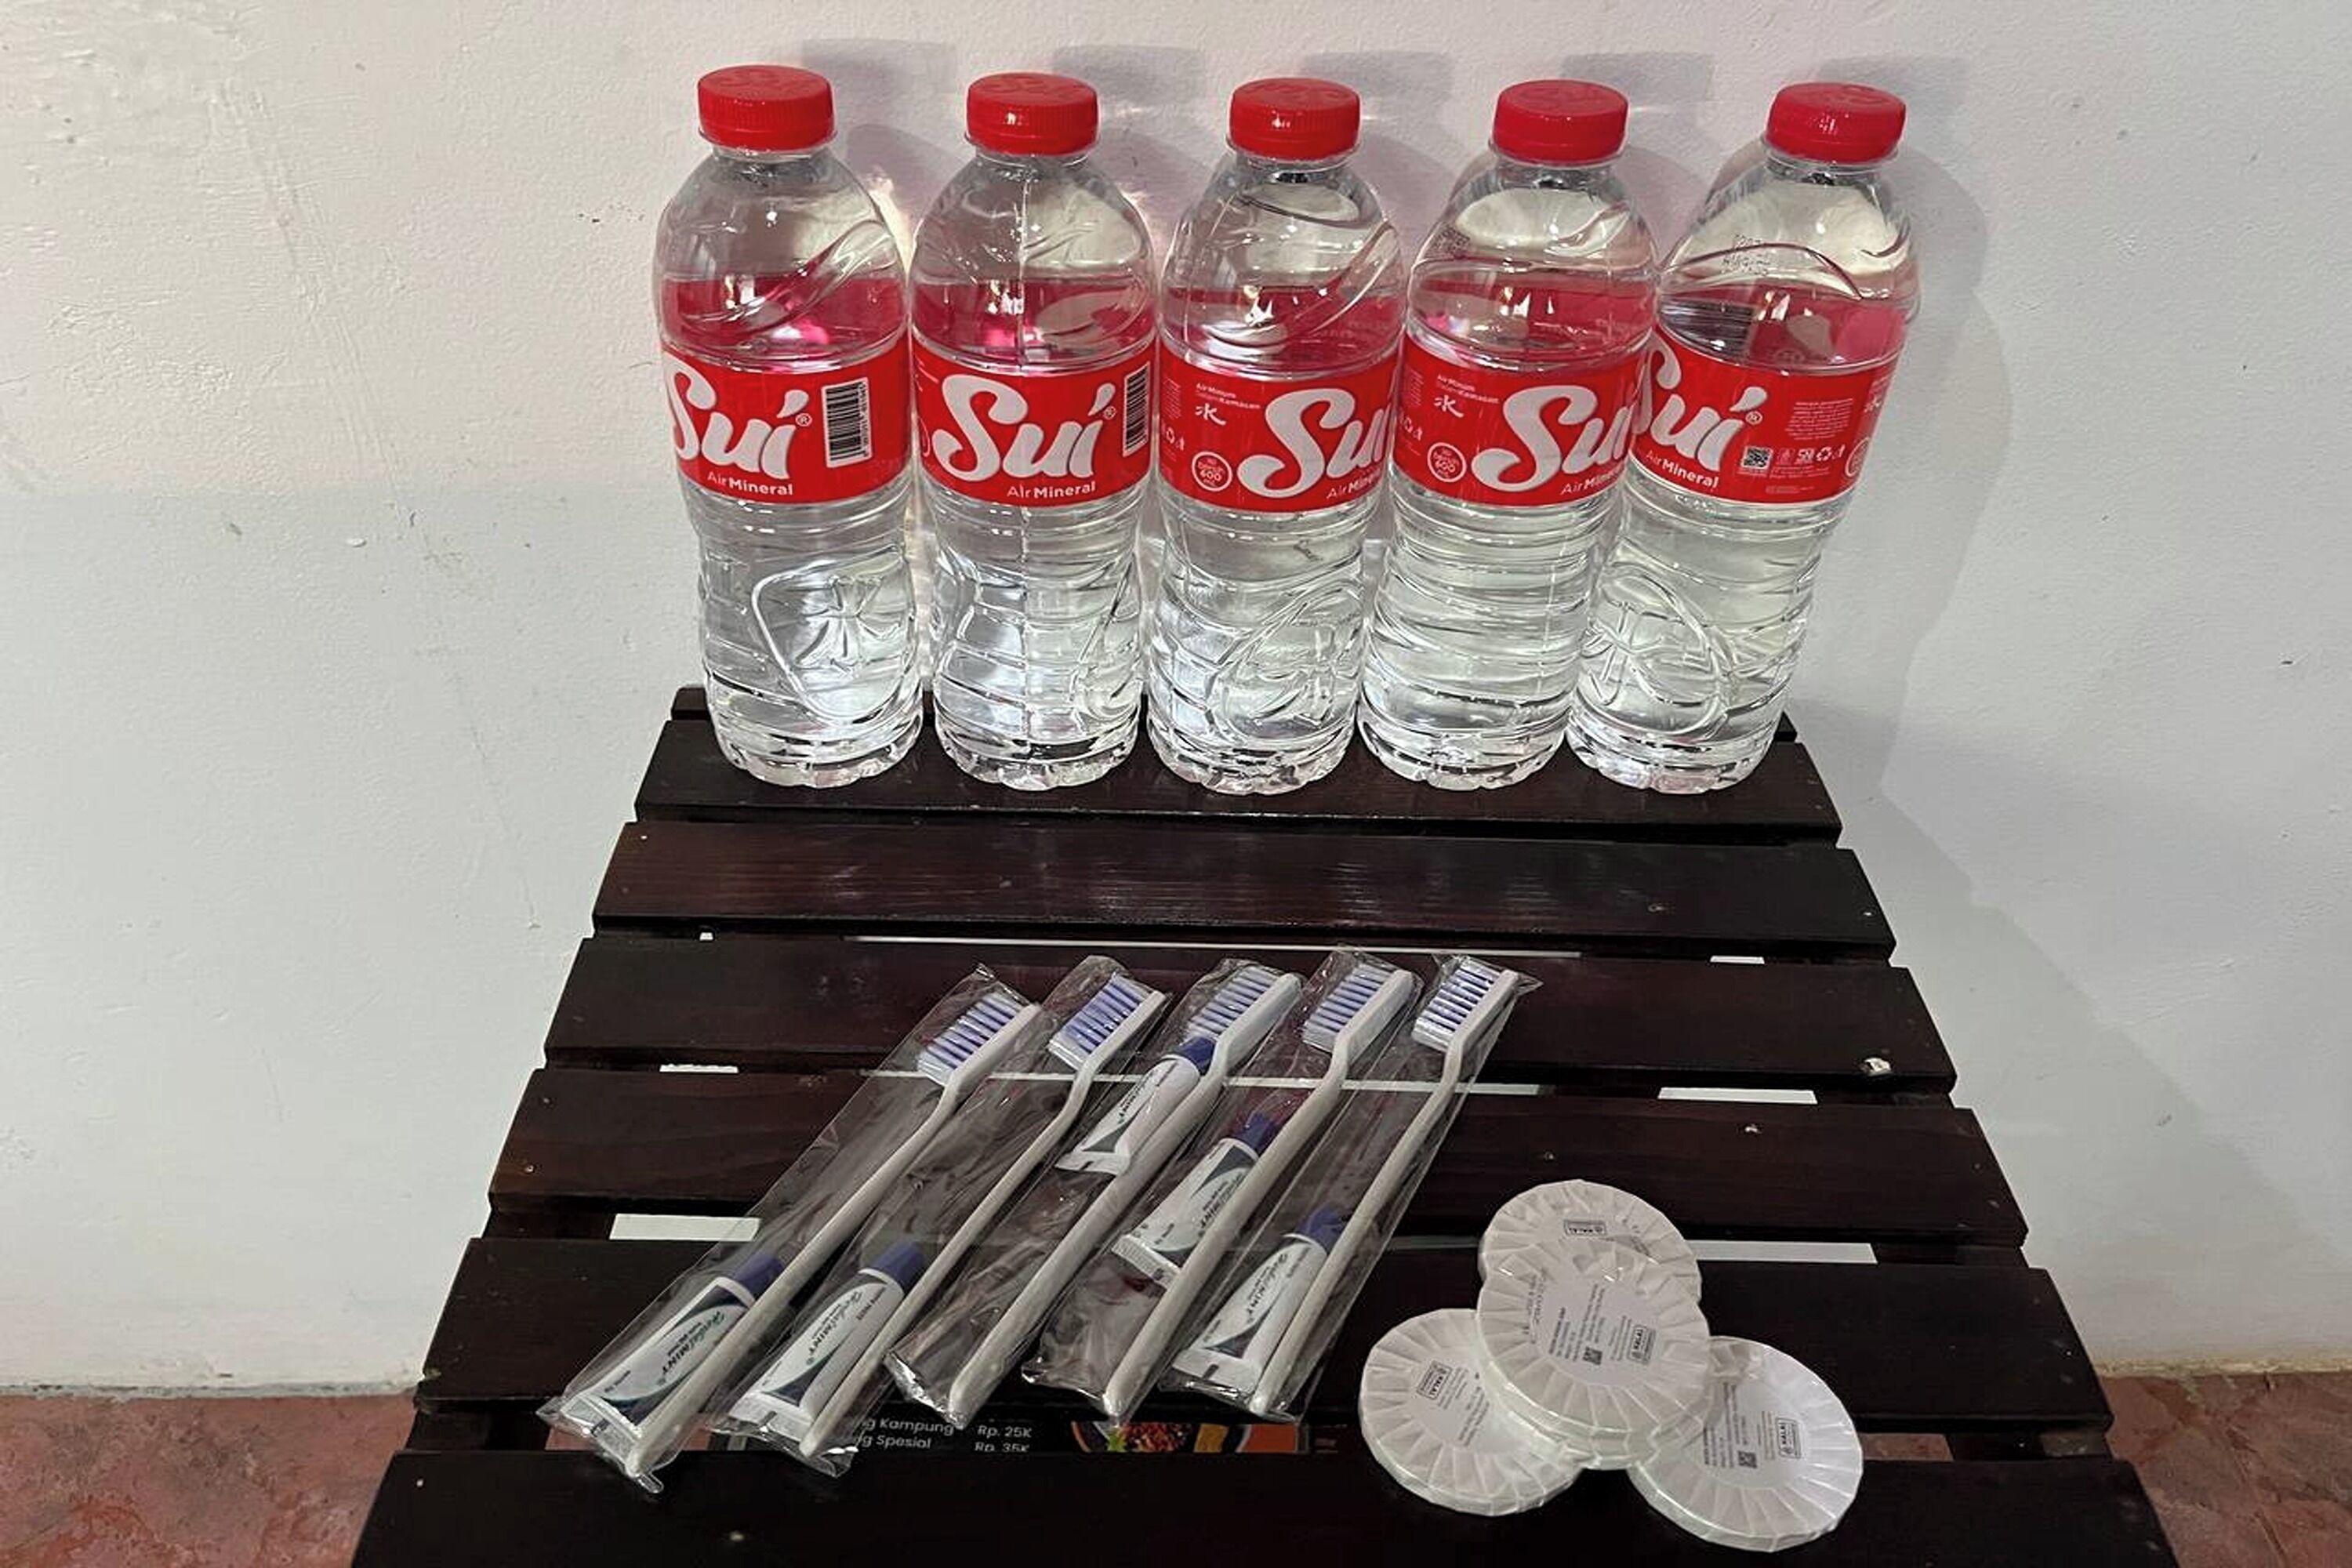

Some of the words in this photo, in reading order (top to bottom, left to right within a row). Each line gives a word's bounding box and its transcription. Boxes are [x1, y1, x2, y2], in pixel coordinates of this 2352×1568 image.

[879, 1417, 954, 1436] Kampung
[978, 1425, 1000, 1439] Rp.
[1004, 1426, 1032, 1439] 25K
[876, 1435, 932, 1450] Spesial
